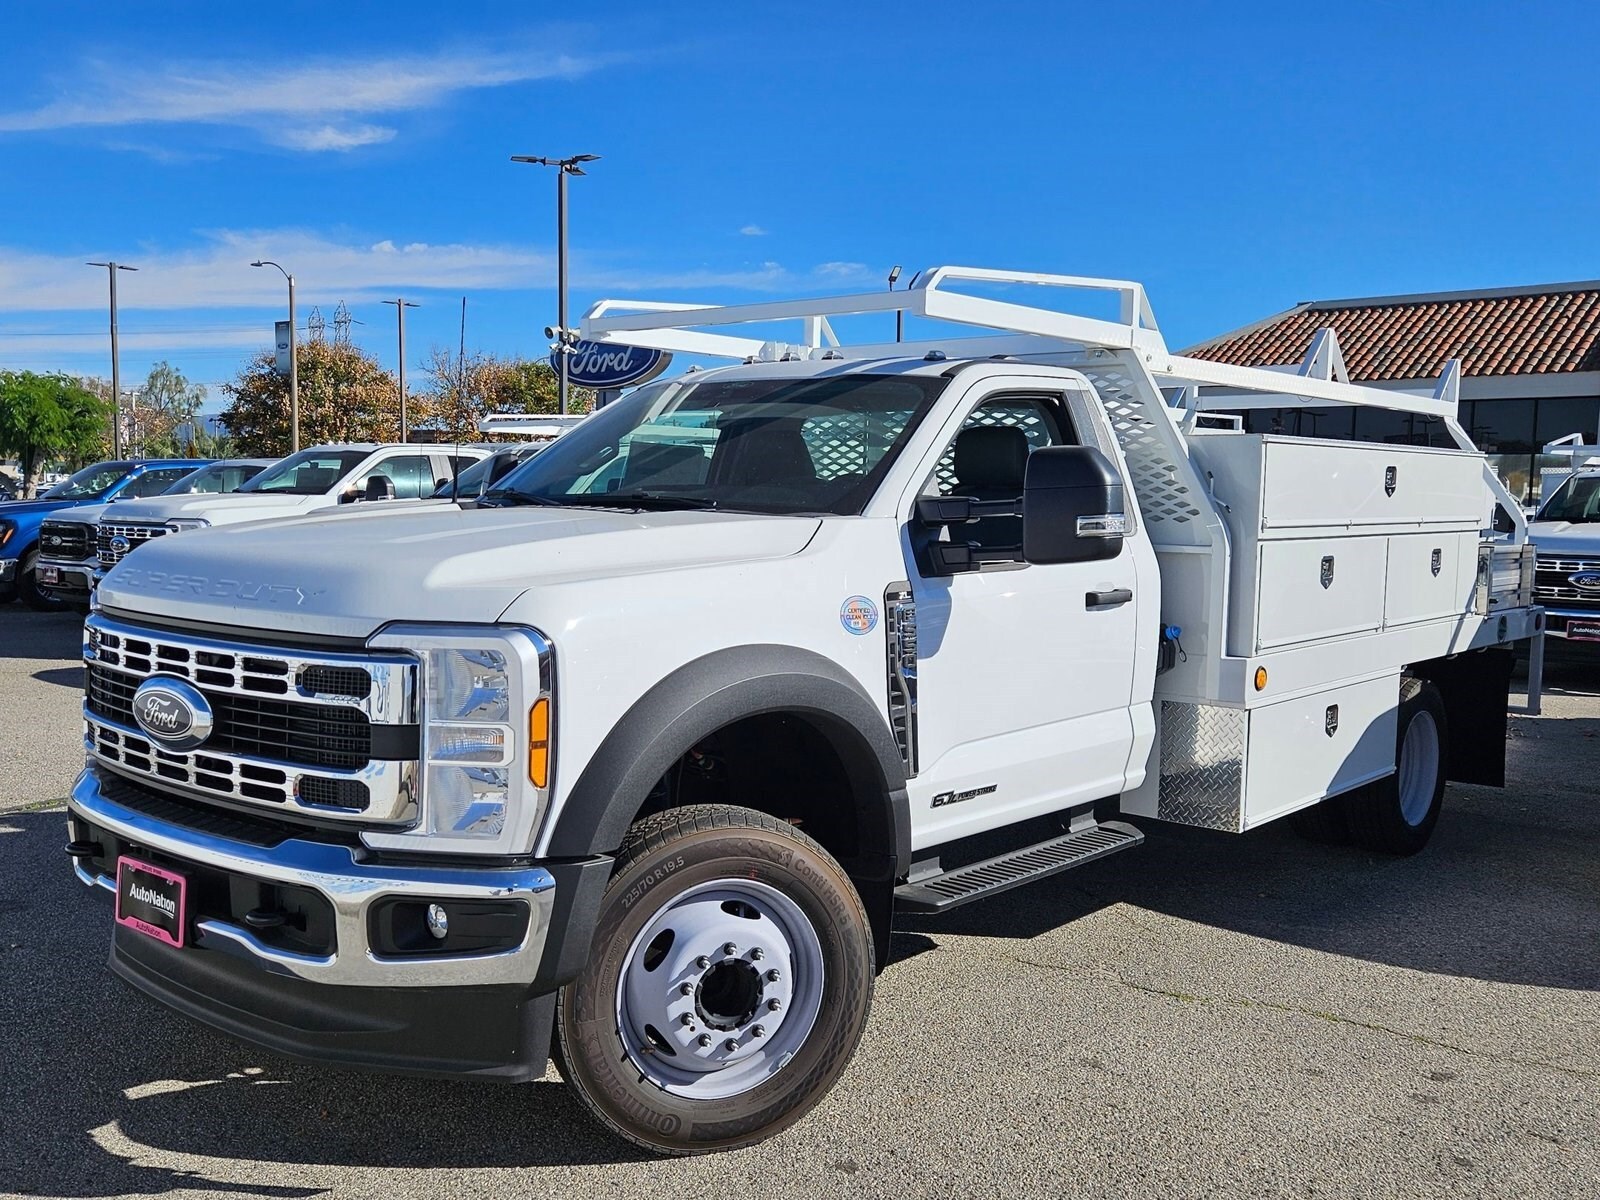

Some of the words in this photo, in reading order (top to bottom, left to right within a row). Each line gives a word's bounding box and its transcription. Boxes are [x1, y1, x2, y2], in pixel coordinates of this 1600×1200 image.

[570, 341, 633, 374] Ford
[209, 578, 326, 605] DUTY
[144, 696, 179, 729] Ford
[621, 875, 655, 908] 225/70
[654, 868, 664, 879] R
[662, 856, 685, 873] 19.5
[794, 858, 828, 890] Conti
[129, 882, 175, 913] AutoNation
